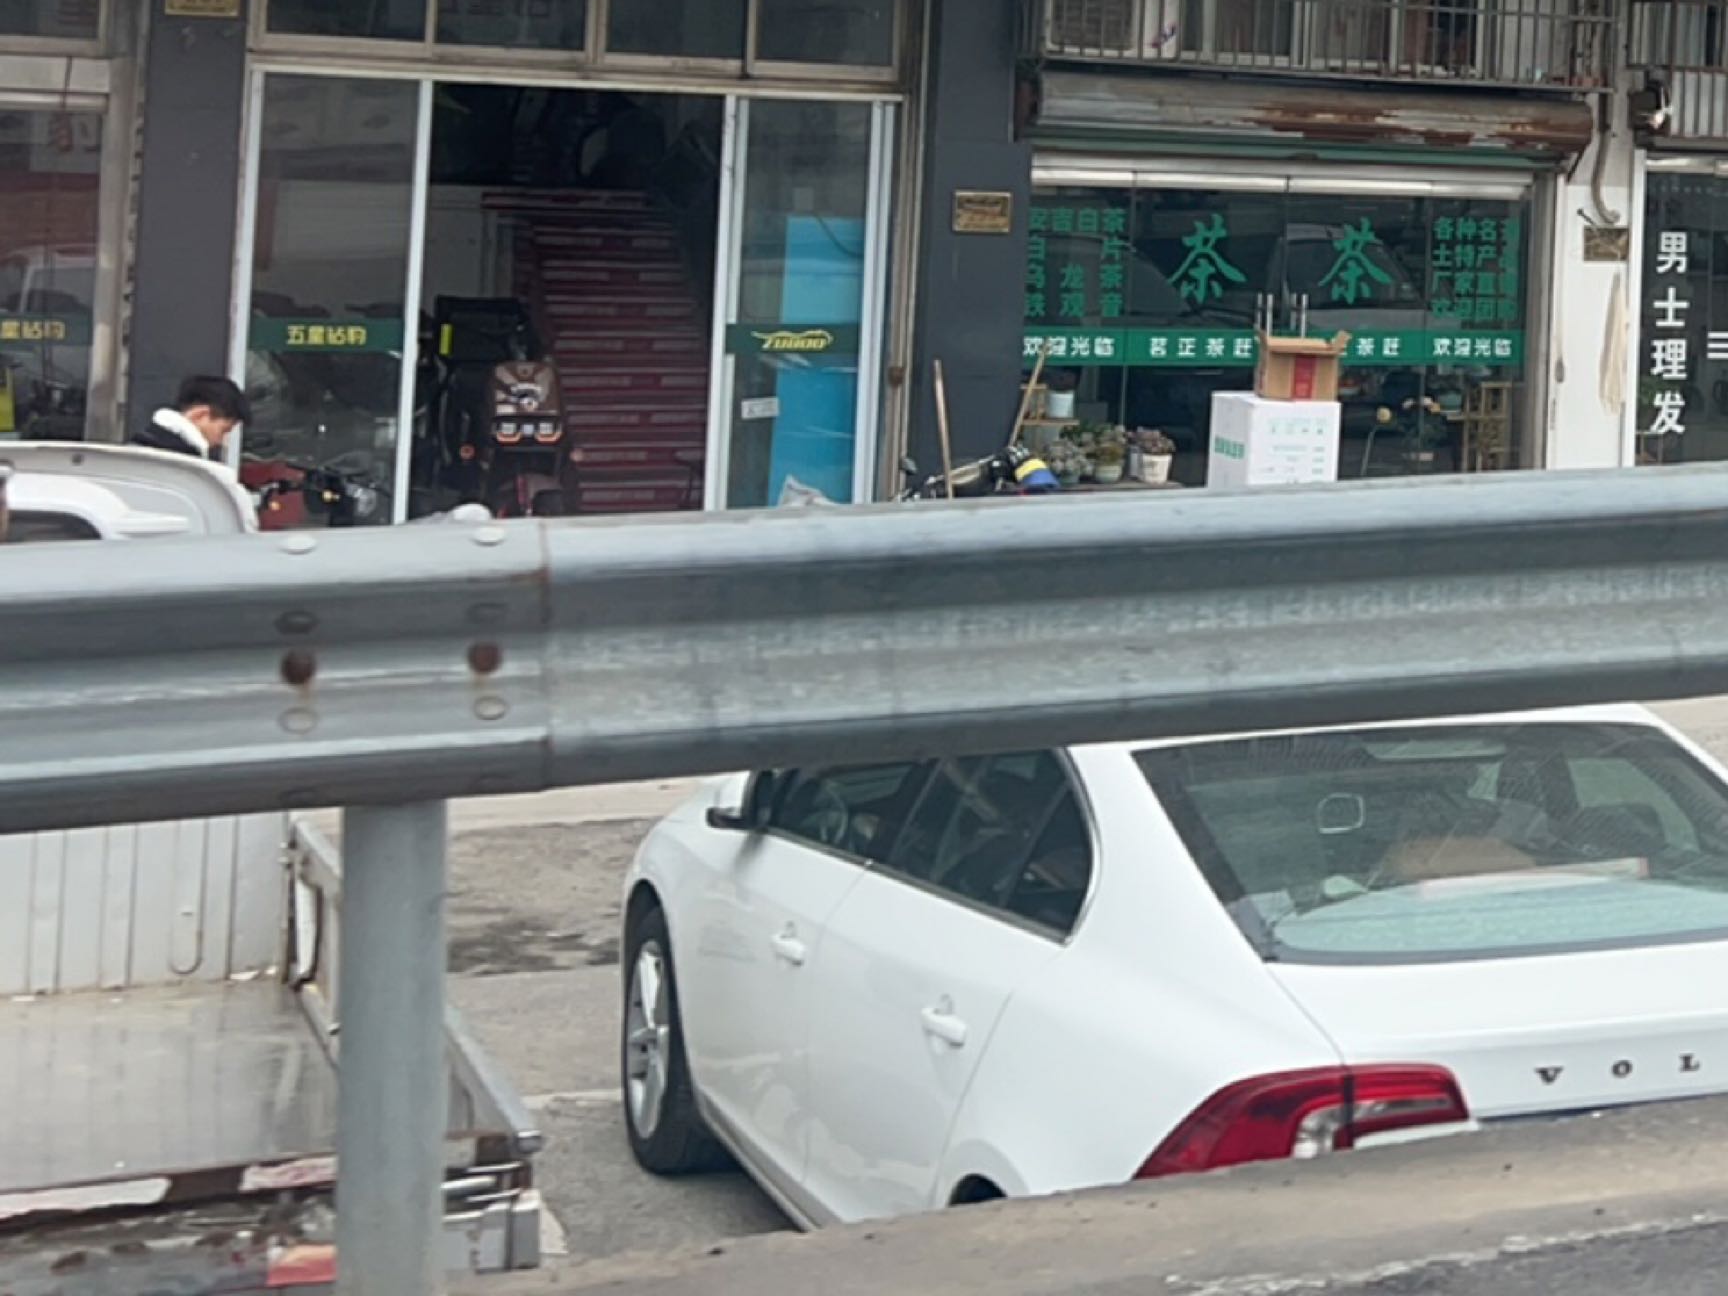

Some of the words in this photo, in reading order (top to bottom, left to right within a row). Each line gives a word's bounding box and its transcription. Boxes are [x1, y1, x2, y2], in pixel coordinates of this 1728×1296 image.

[1166, 213, 1247, 305] 茶
[1318, 216, 1392, 305] 茶
[1022, 335, 1116, 358] 欢迎光临
[1432, 337, 1513, 358] 欢迎光临
[1649, 231, 1690, 435] 男士理发
